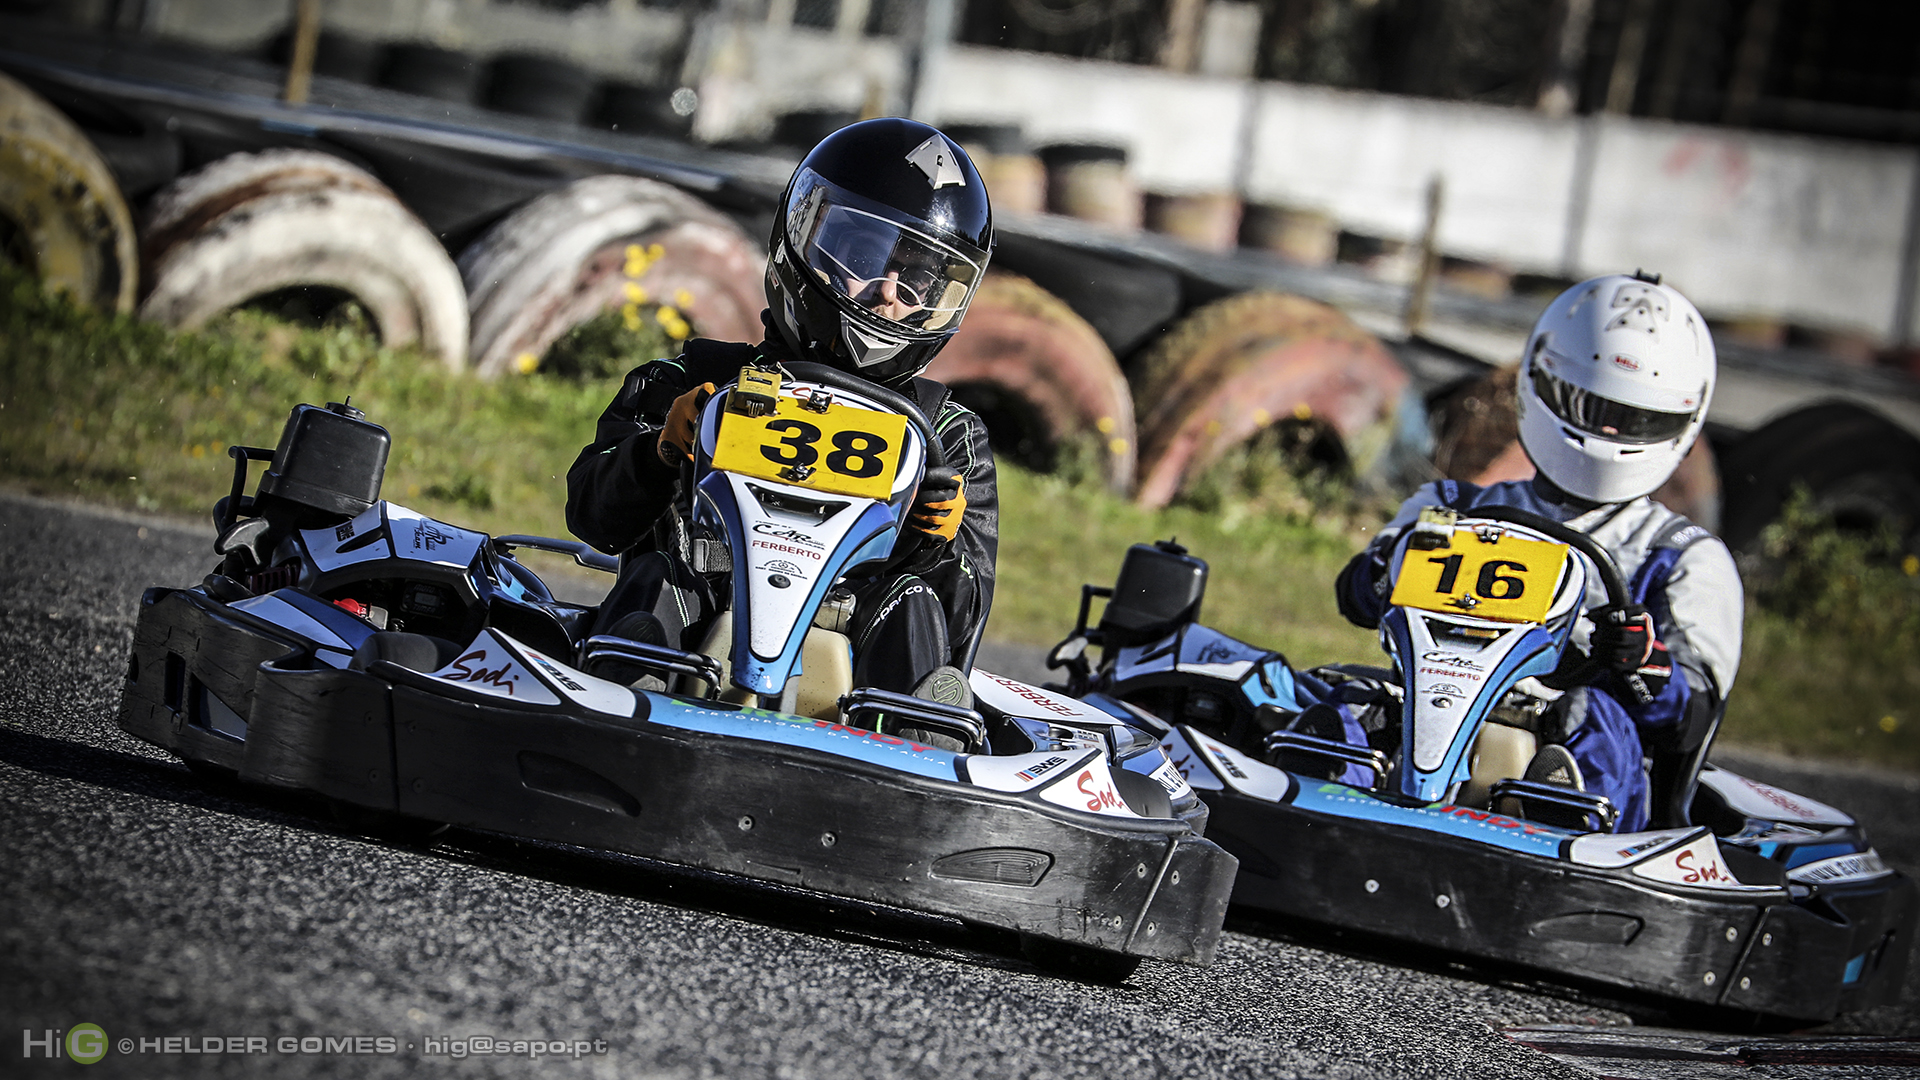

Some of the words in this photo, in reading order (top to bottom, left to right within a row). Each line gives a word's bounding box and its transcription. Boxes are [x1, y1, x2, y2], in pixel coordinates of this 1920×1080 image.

[760, 419, 888, 478] 38
[752, 540, 821, 560] FERBERTO
[1427, 554, 1529, 599] 16
[442, 650, 519, 695] Sodi
[1028, 756, 1068, 776] SWS
